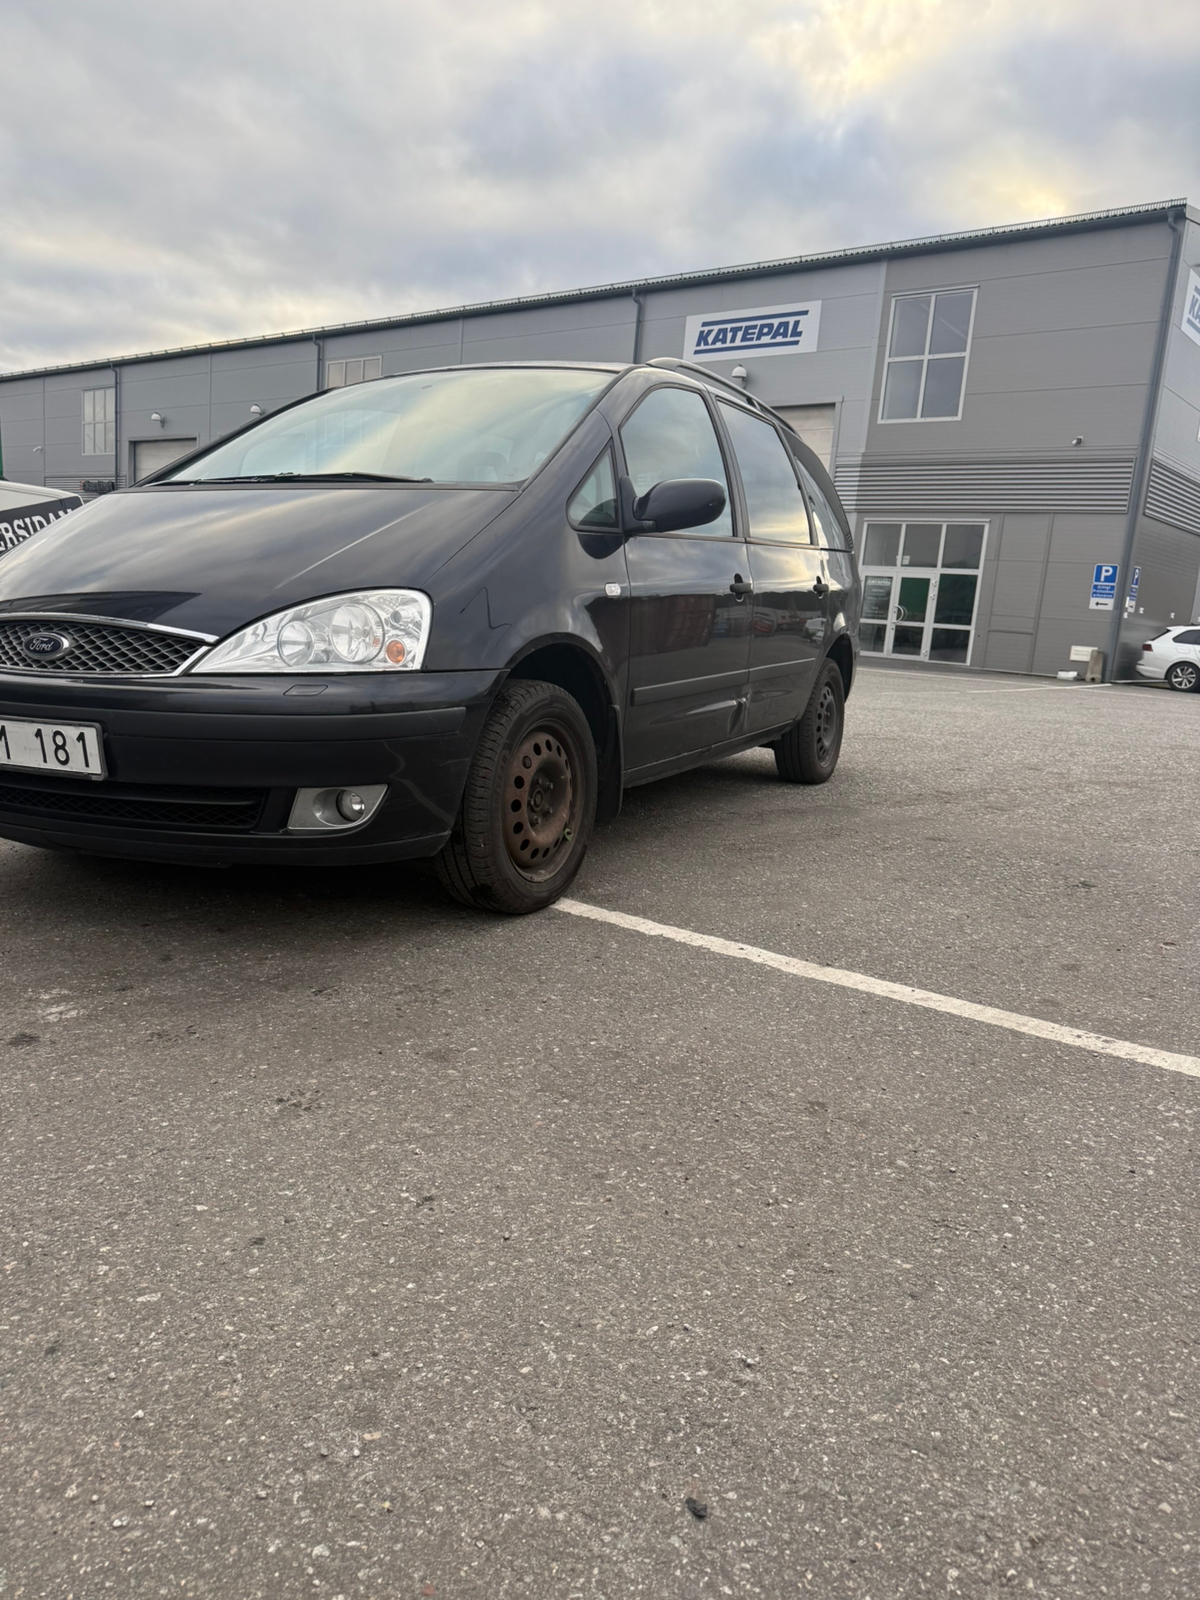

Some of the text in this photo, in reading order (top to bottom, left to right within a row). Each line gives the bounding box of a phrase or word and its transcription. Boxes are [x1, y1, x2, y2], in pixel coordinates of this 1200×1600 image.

[695, 319, 803, 347] KATEPAL
[1100, 566, 1113, 582] P
[29, 637, 55, 651] Ford
[34, 727, 90, 768] 181
